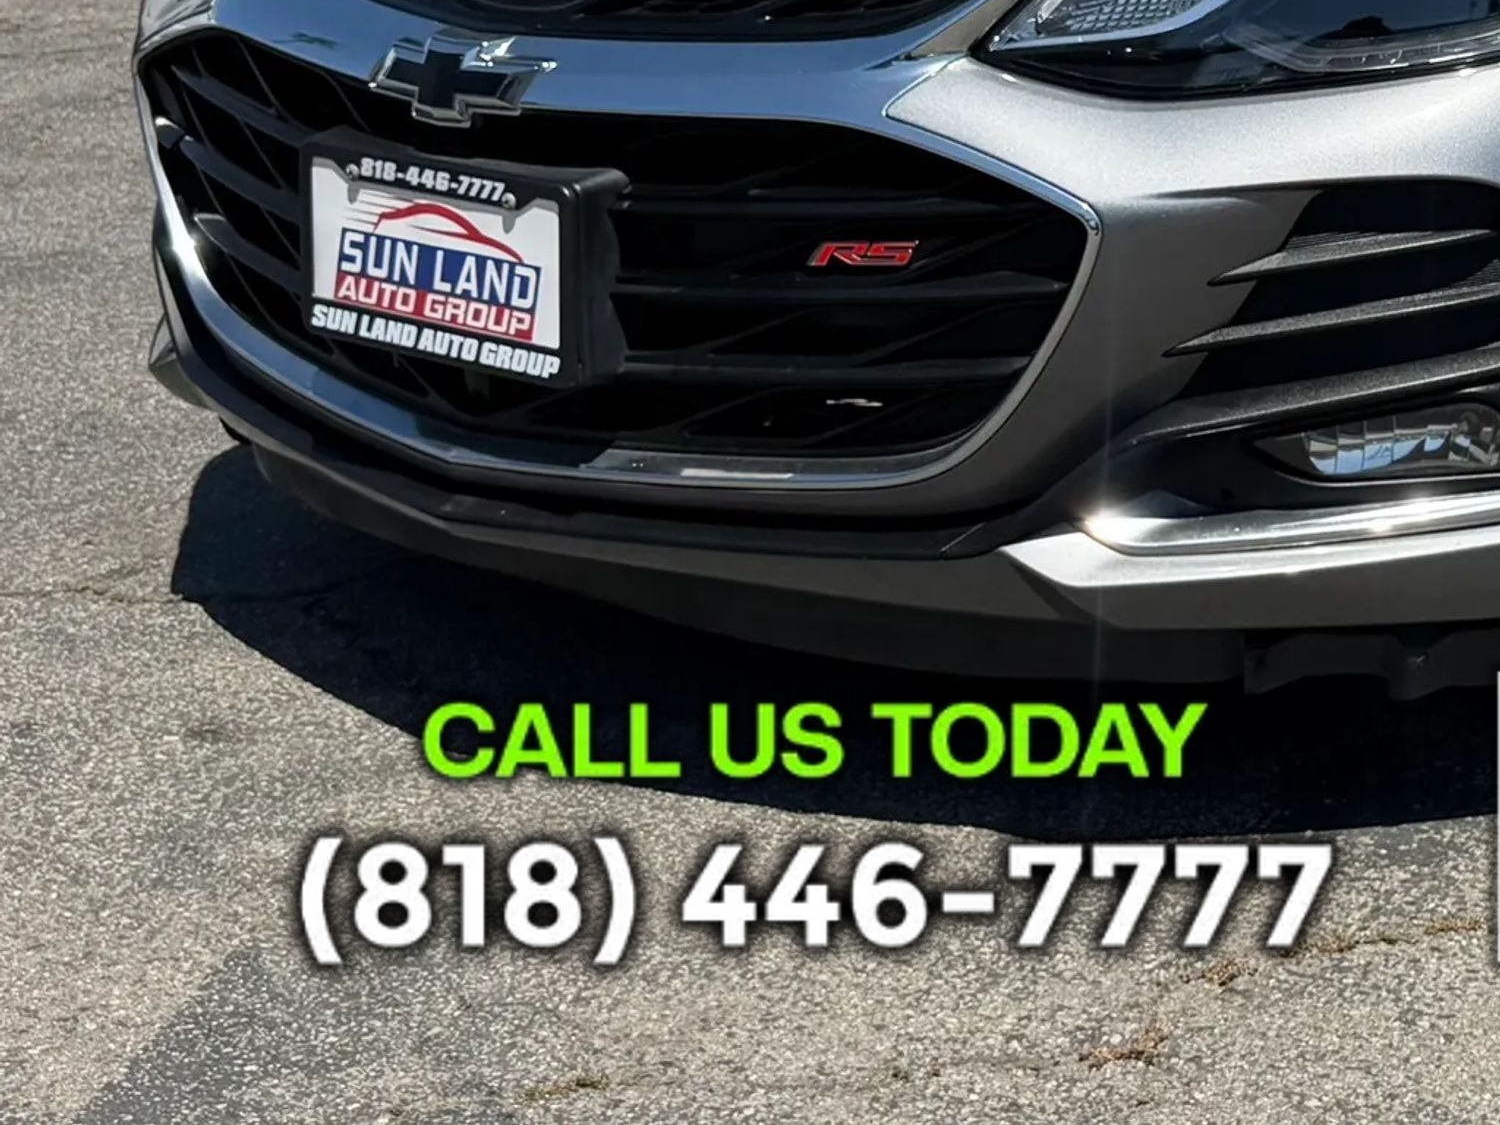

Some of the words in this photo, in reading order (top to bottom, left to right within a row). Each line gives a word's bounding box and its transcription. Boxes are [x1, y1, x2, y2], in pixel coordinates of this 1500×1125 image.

[359, 157, 505, 201] 818-446-7777
[340, 231, 419, 286] SUN
[431, 249, 536, 310] LAND
[806, 241, 919, 266] RS
[337, 277, 417, 312] AUTO
[423, 293, 532, 335] GROUP
[311, 303, 358, 335] SUN
[358, 315, 421, 350] LAND
[418, 331, 483, 362] AUTO
[479, 345, 561, 379] GROUP
